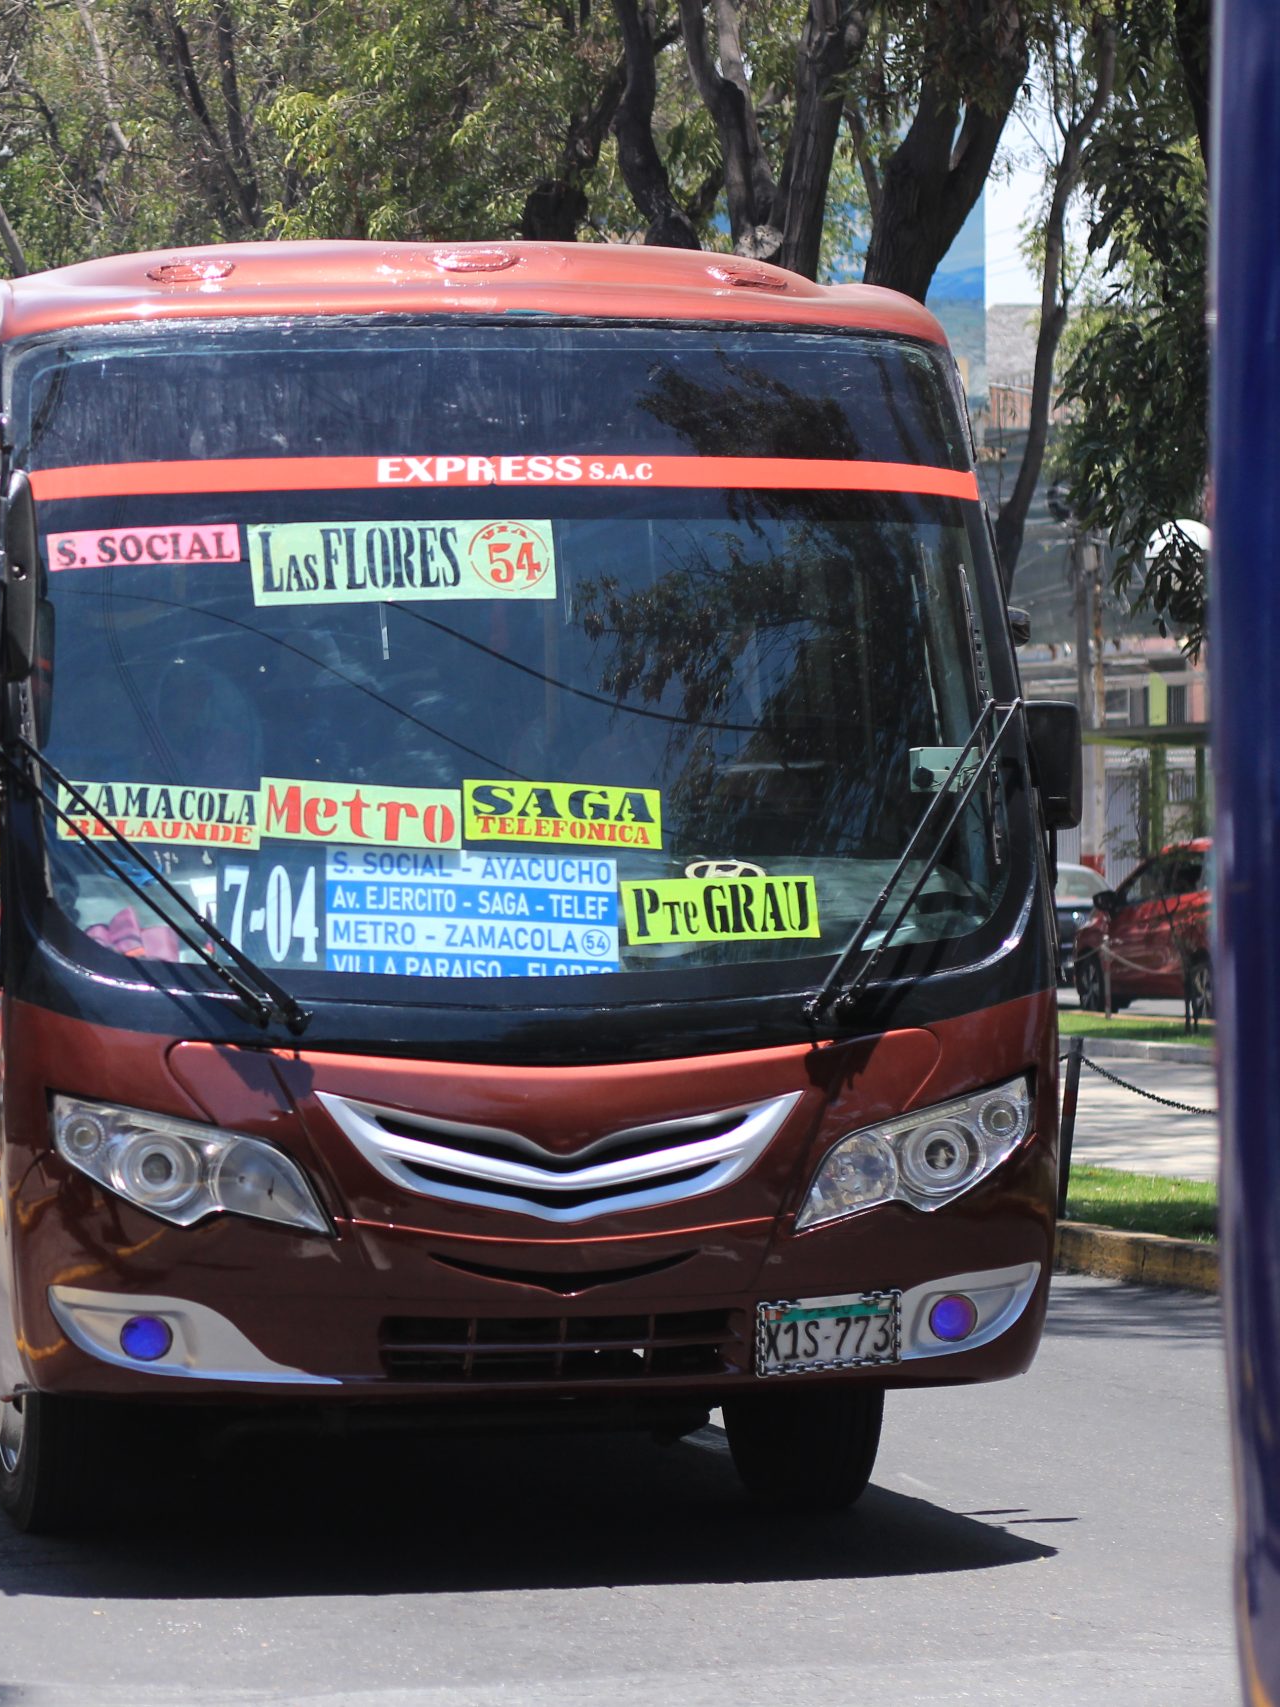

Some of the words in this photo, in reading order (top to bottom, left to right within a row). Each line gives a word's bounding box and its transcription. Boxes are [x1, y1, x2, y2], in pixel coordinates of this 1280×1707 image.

[377, 456, 583, 483] EXPRESS
[589, 460, 654, 481] S.A.C
[57, 539, 88, 566] S.
[98, 531, 235, 565] SOCIAL
[488, 542, 542, 583] 54
[64, 785, 257, 825] ZAMACOLA
[266, 785, 455, 843] Metro
[472, 785, 655, 823] SAGA
[66, 819, 253, 845] BELAUNDE
[477, 816, 650, 845] TELEFONICA
[333, 851, 354, 874] S.
[363, 852, 453, 877] SOCIAL
[482, 857, 612, 885] AYACUCHO
[332, 885, 360, 909] Av.
[365, 886, 456, 912] EJERCITO
[478, 890, 530, 916] SAGA
[548, 894, 609, 920] TELEF
[333, 919, 416, 945] METRO
[445, 924, 578, 953] ZAMACOLA
[586, 935, 606, 950] 54
[406, 957, 501, 977] PARAISO
